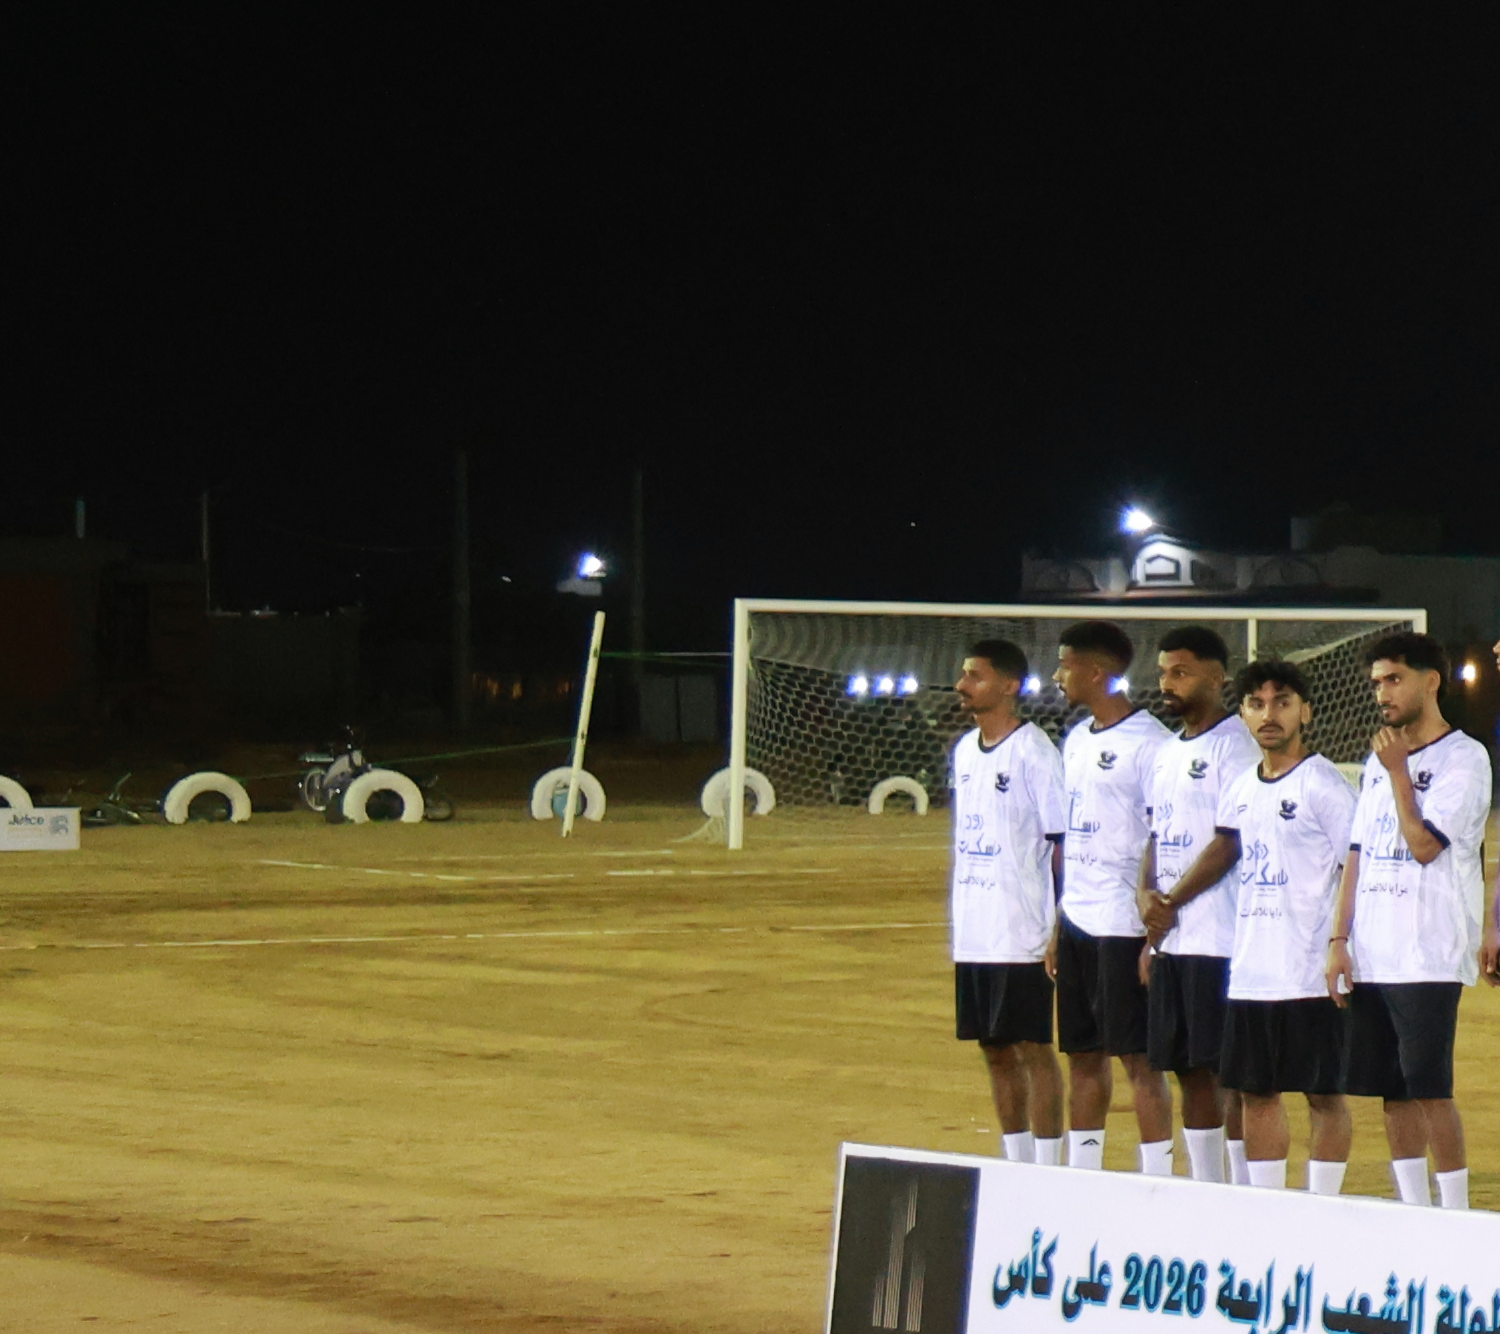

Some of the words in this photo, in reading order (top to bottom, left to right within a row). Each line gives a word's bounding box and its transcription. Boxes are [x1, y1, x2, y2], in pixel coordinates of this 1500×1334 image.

[992, 1226, 1058, 1309] كأس
[1062, 1239, 1113, 1322] على
[1119, 1252, 1209, 1318] 2026
